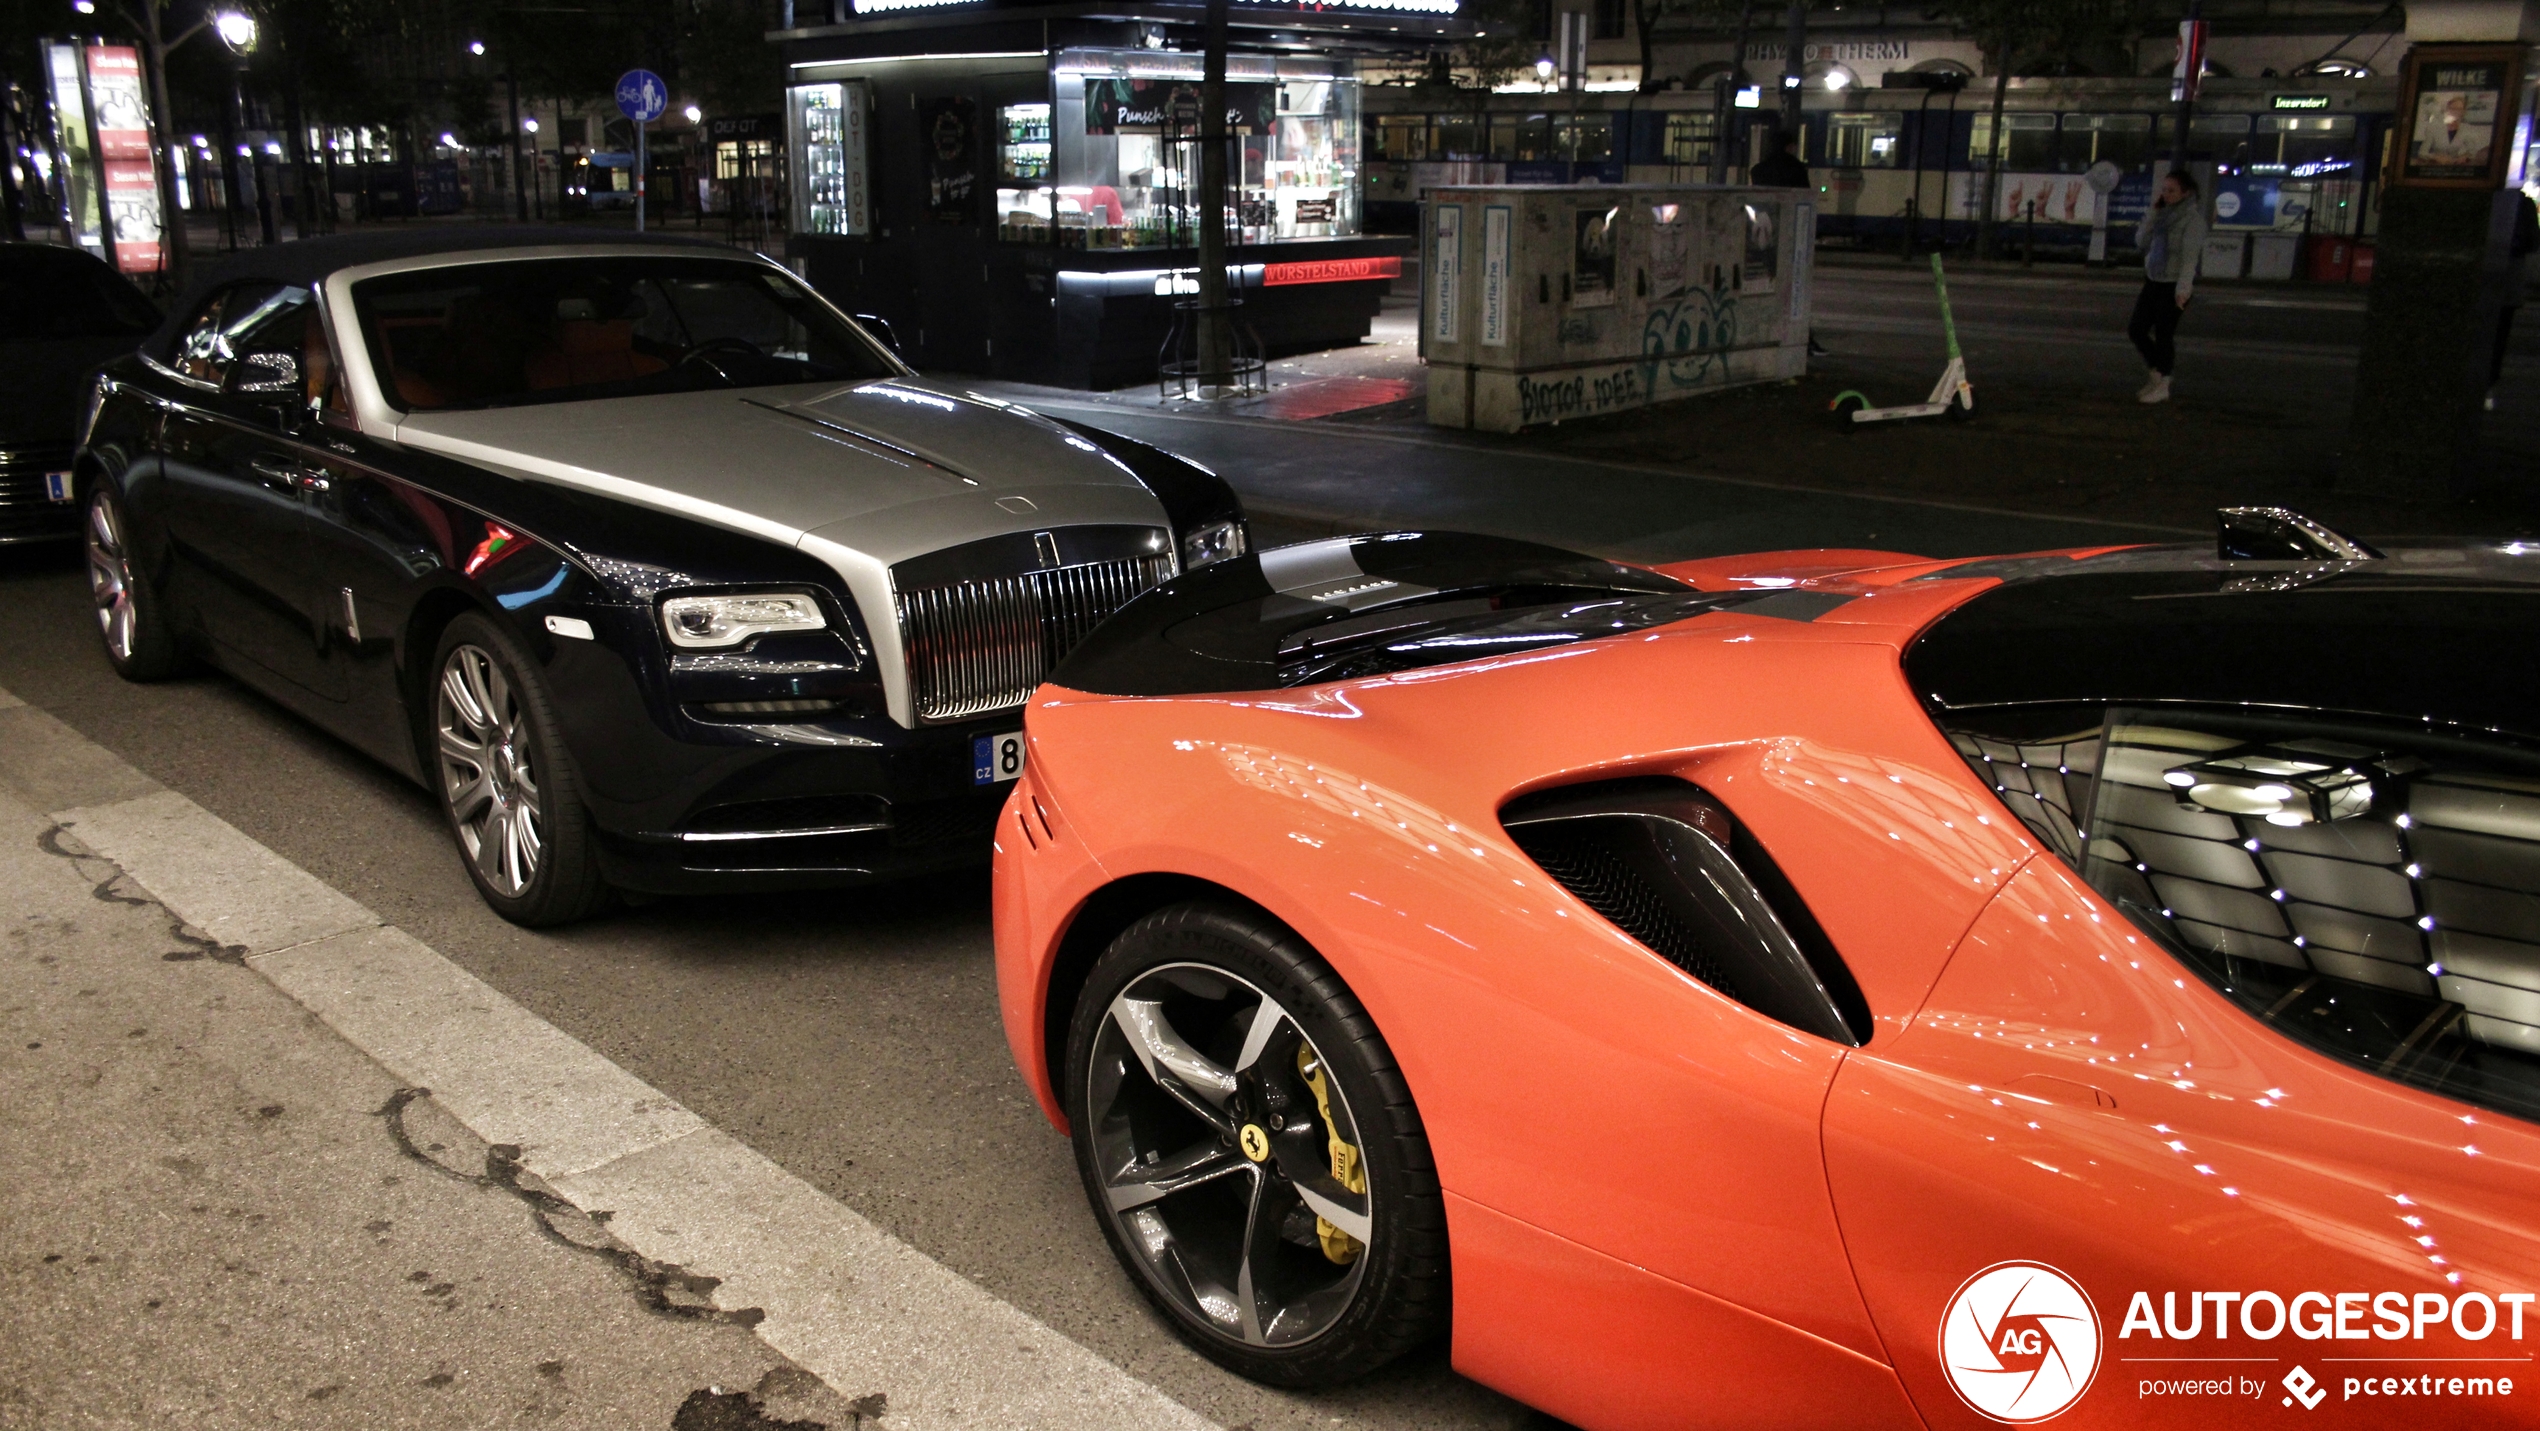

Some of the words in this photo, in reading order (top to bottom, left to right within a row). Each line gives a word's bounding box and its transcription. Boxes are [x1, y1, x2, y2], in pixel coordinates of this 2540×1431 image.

[1746, 44, 1817, 60] PHYO
[1832, 41, 1908, 60] THERM
[2436, 70, 2487, 87] WILKE
[2275, 97, 2328, 109] Inzersdorf
[1117, 106, 1164, 124] Punsch
[113, 171, 139, 182] Susan
[1265, 261, 1370, 282] WÜRSTELSTAND
[1439, 260, 1450, 336] Kulturfläche
[1487, 261, 1498, 340] Kulturfläche
[1001, 738, 1019, 774] 8
[976, 767, 991, 779] CZ
